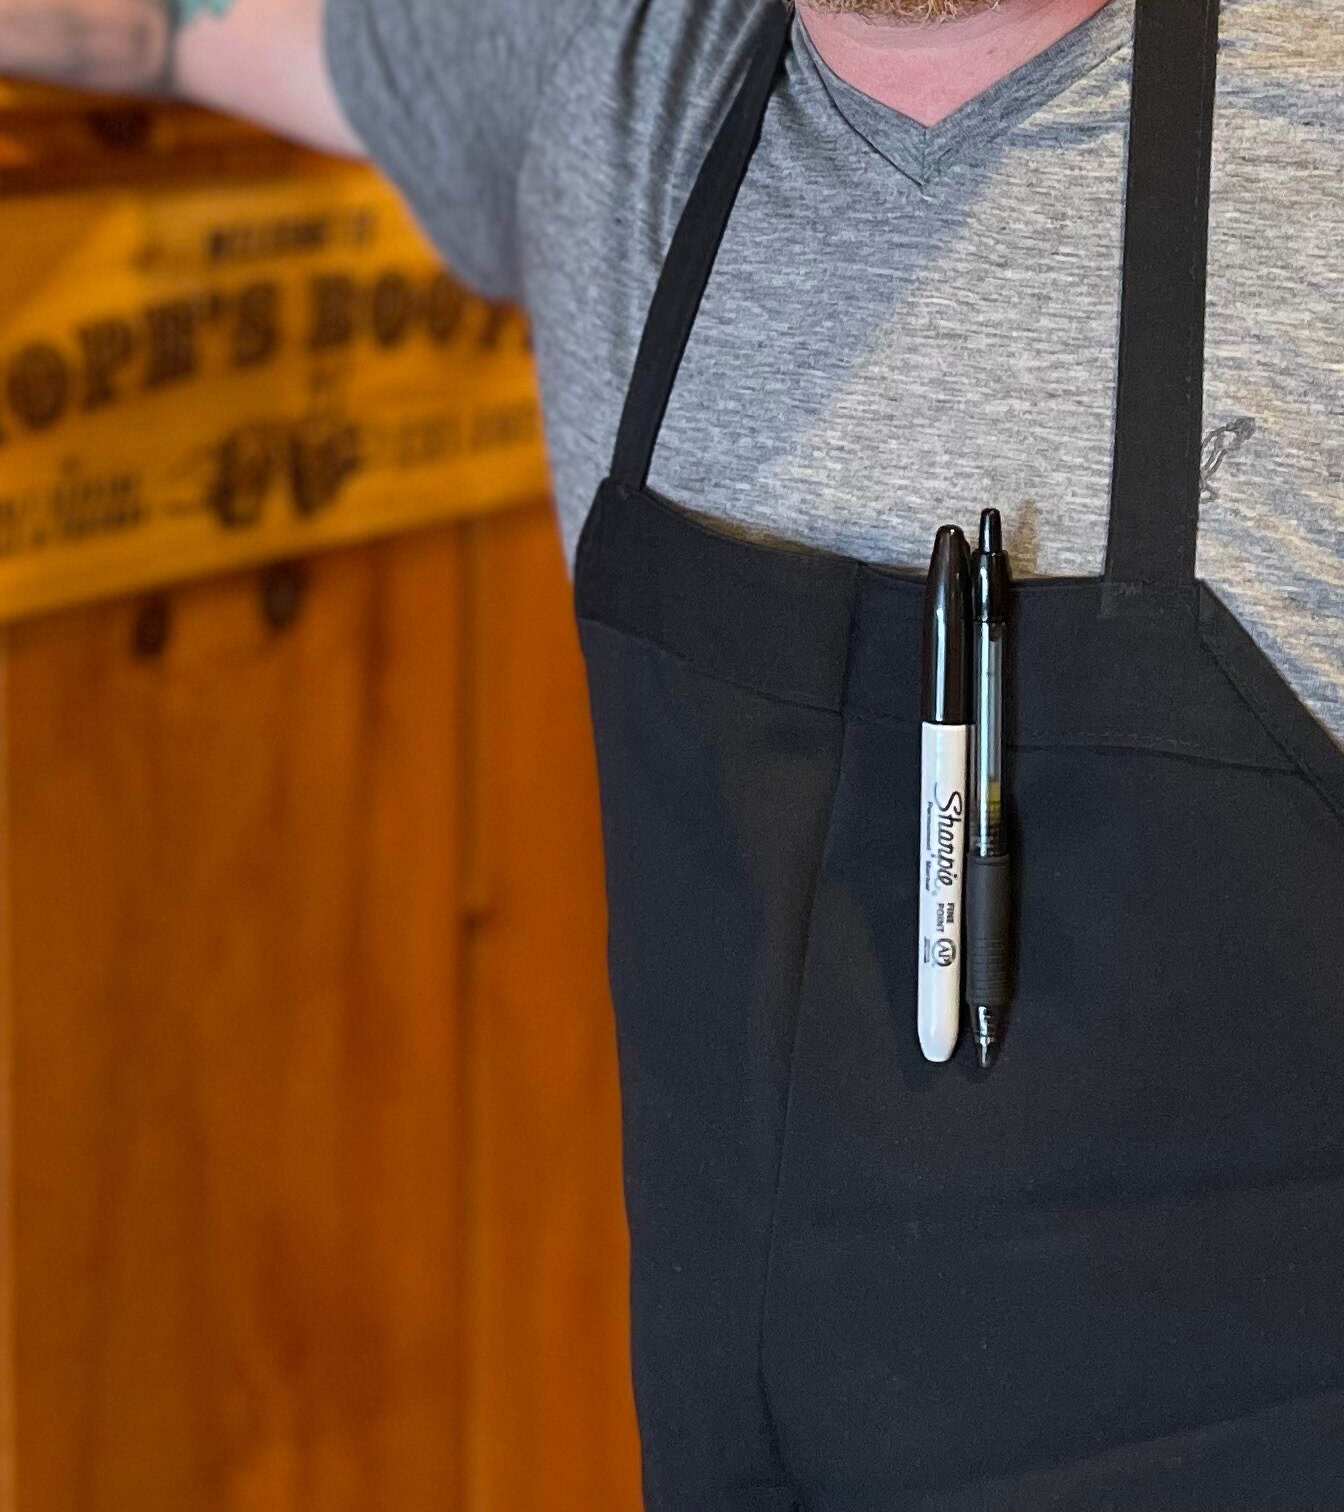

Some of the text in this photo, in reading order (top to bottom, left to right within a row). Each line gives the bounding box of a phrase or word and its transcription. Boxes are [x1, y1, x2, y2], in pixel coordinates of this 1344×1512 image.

[932, 782, 962, 887] Sharpie
[936, 902, 945, 933] POINT
[946, 902, 955, 925] FINE
